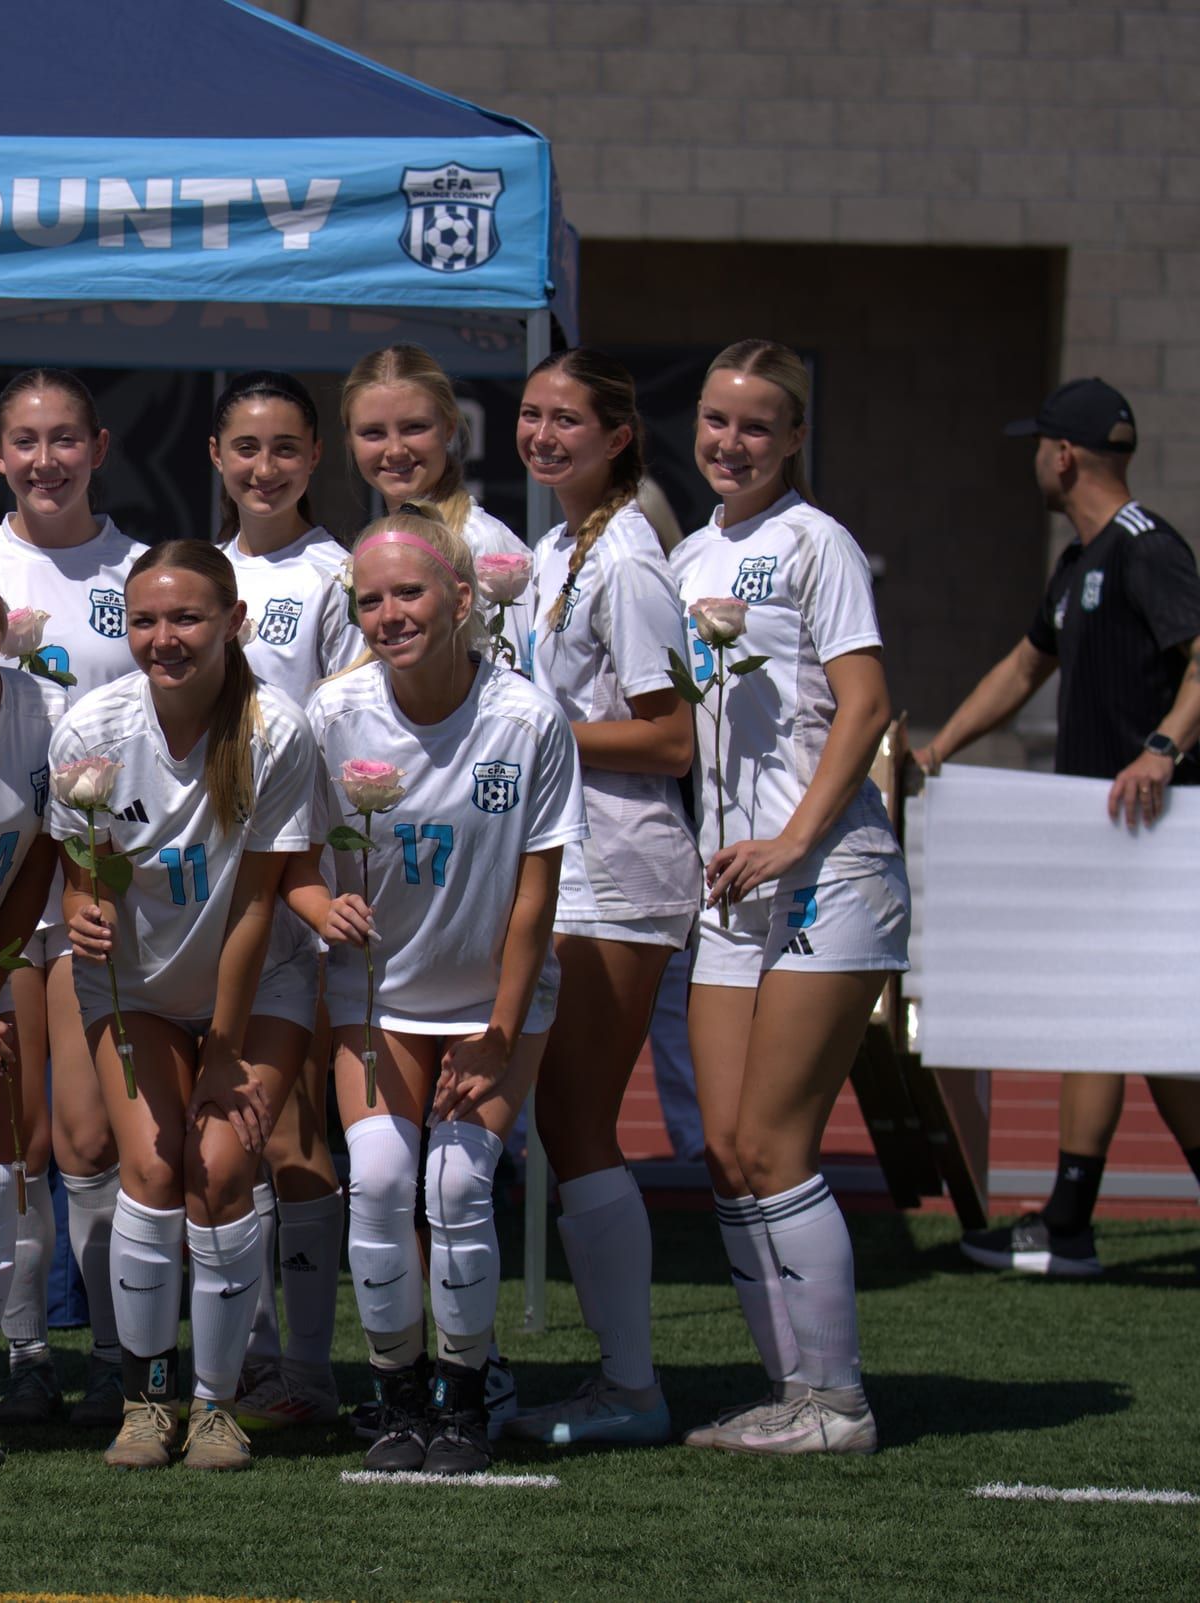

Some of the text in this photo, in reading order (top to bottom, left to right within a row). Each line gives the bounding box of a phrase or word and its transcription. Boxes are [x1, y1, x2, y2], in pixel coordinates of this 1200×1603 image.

[433, 178, 472, 190] CFA
[452, 191, 491, 199] COUNTY
[394, 824, 454, 887] 17
[159, 843, 210, 906] 11
